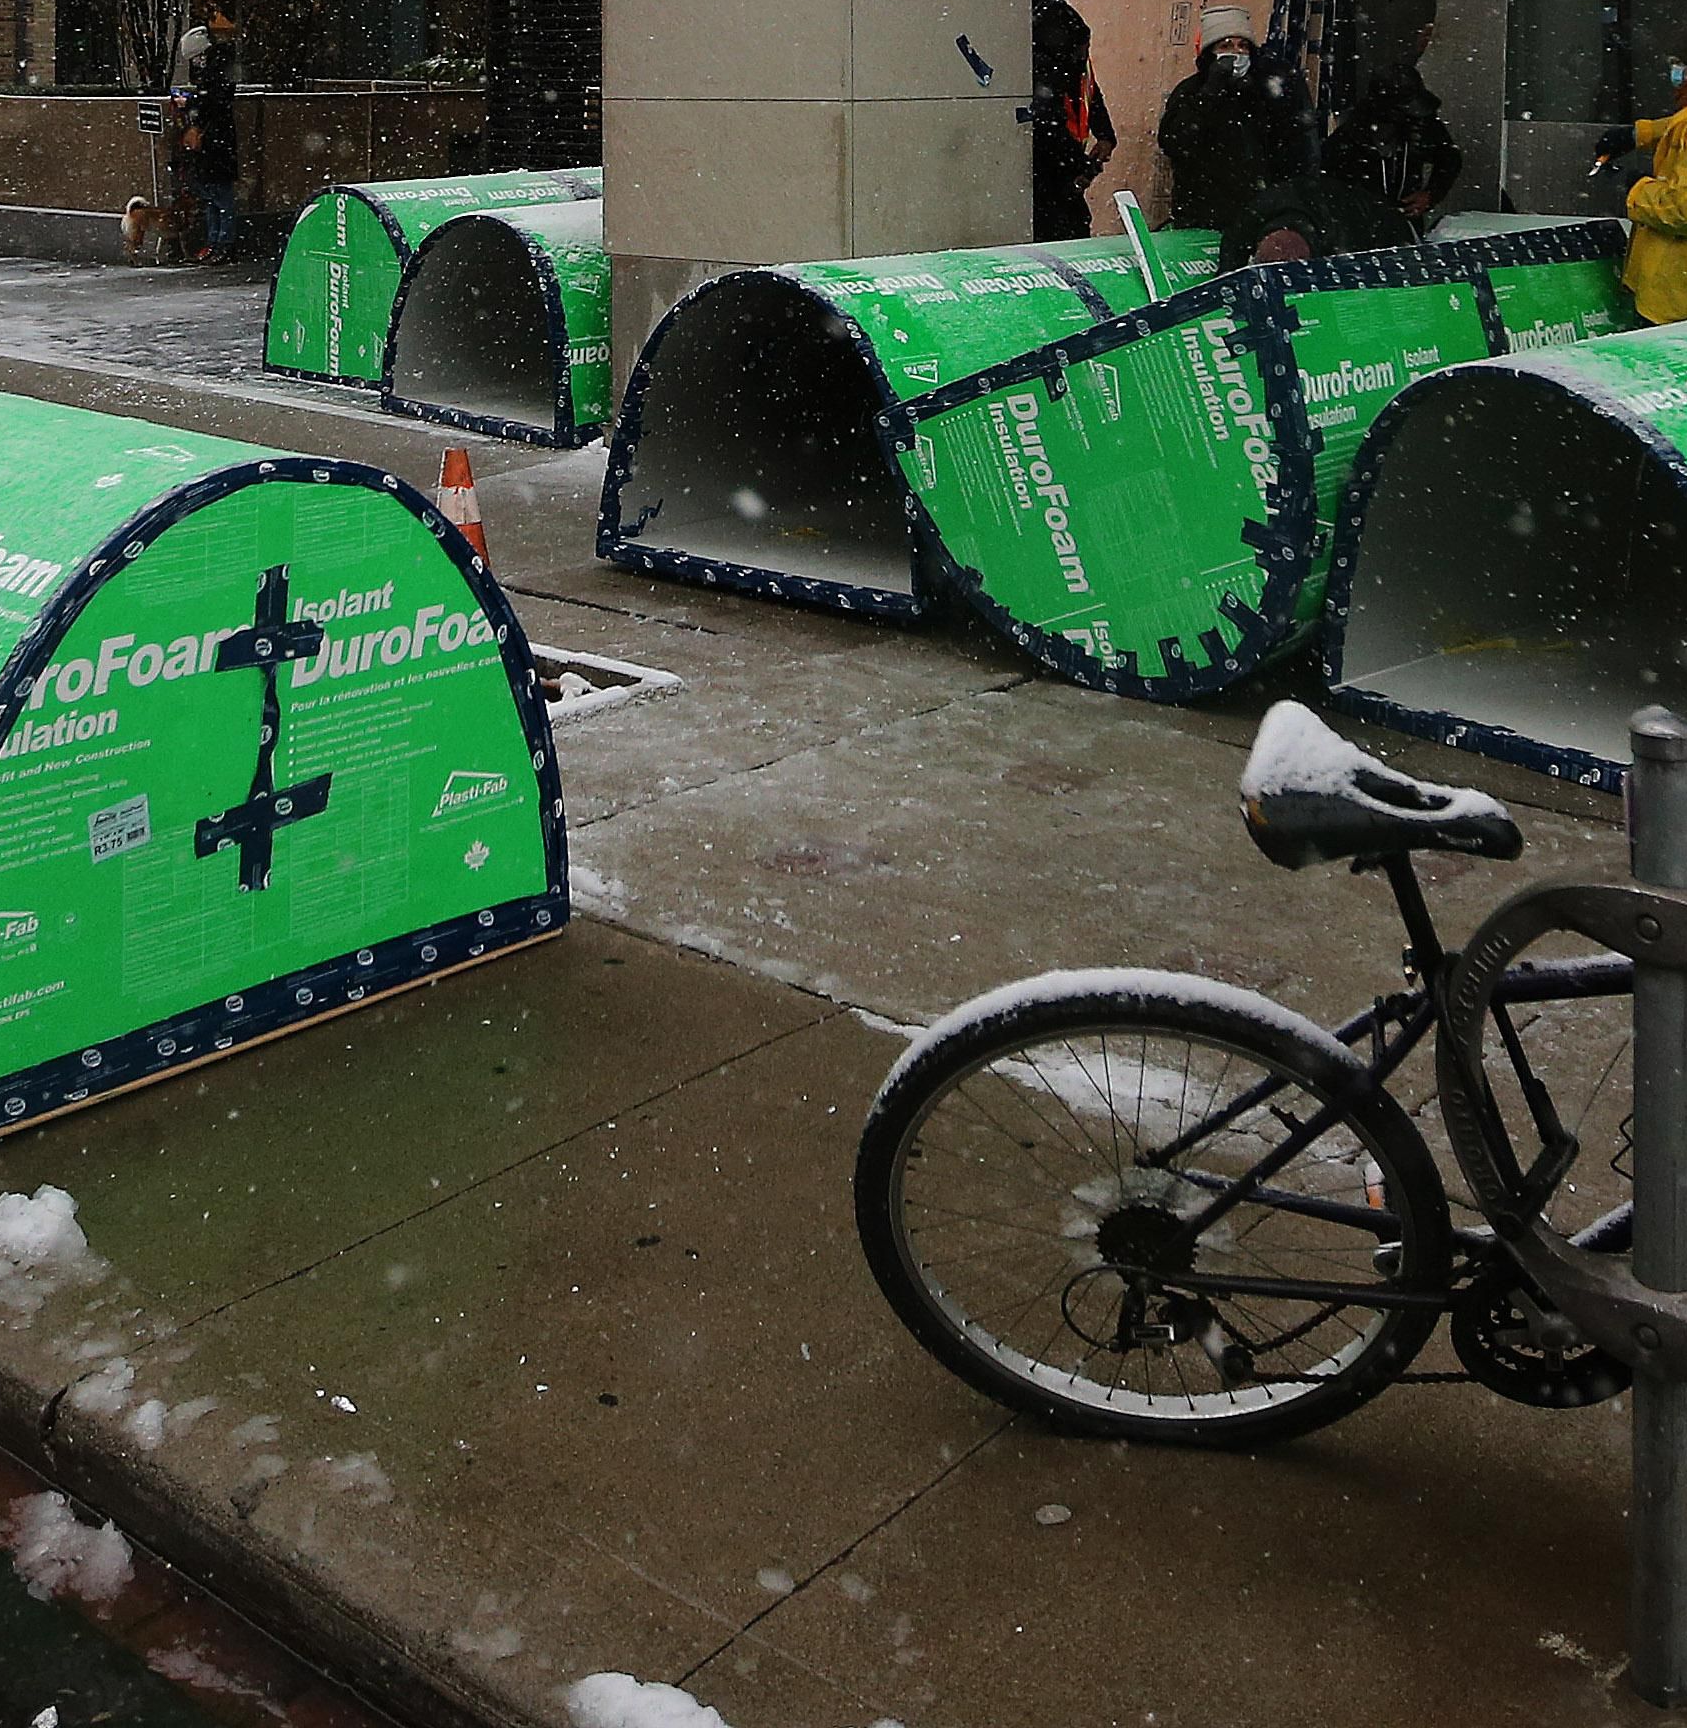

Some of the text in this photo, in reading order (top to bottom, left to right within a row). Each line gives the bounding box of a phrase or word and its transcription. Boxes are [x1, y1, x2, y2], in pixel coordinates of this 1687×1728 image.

[329, 261, 343, 377] DuroFoam
[1180, 327, 1230, 441] Insulation
[987, 402, 1034, 510] Insulation
[1005, 393, 1090, 594] DuroFoam
[292, 579, 396, 627] Isolant
[290, 695, 322, 714] Pour
[320, 694, 330, 706] la
[332, 680, 392, 703] rénovation
[393, 676, 405, 688] et
[407, 672, 425, 686] les
[425, 660, 476, 680] nouvelles
[19, 763, 43, 778] and
[44, 757, 72, 772] New
[74, 738, 152, 765] Construction
[440, 776, 509, 809] Plasti-Fab
